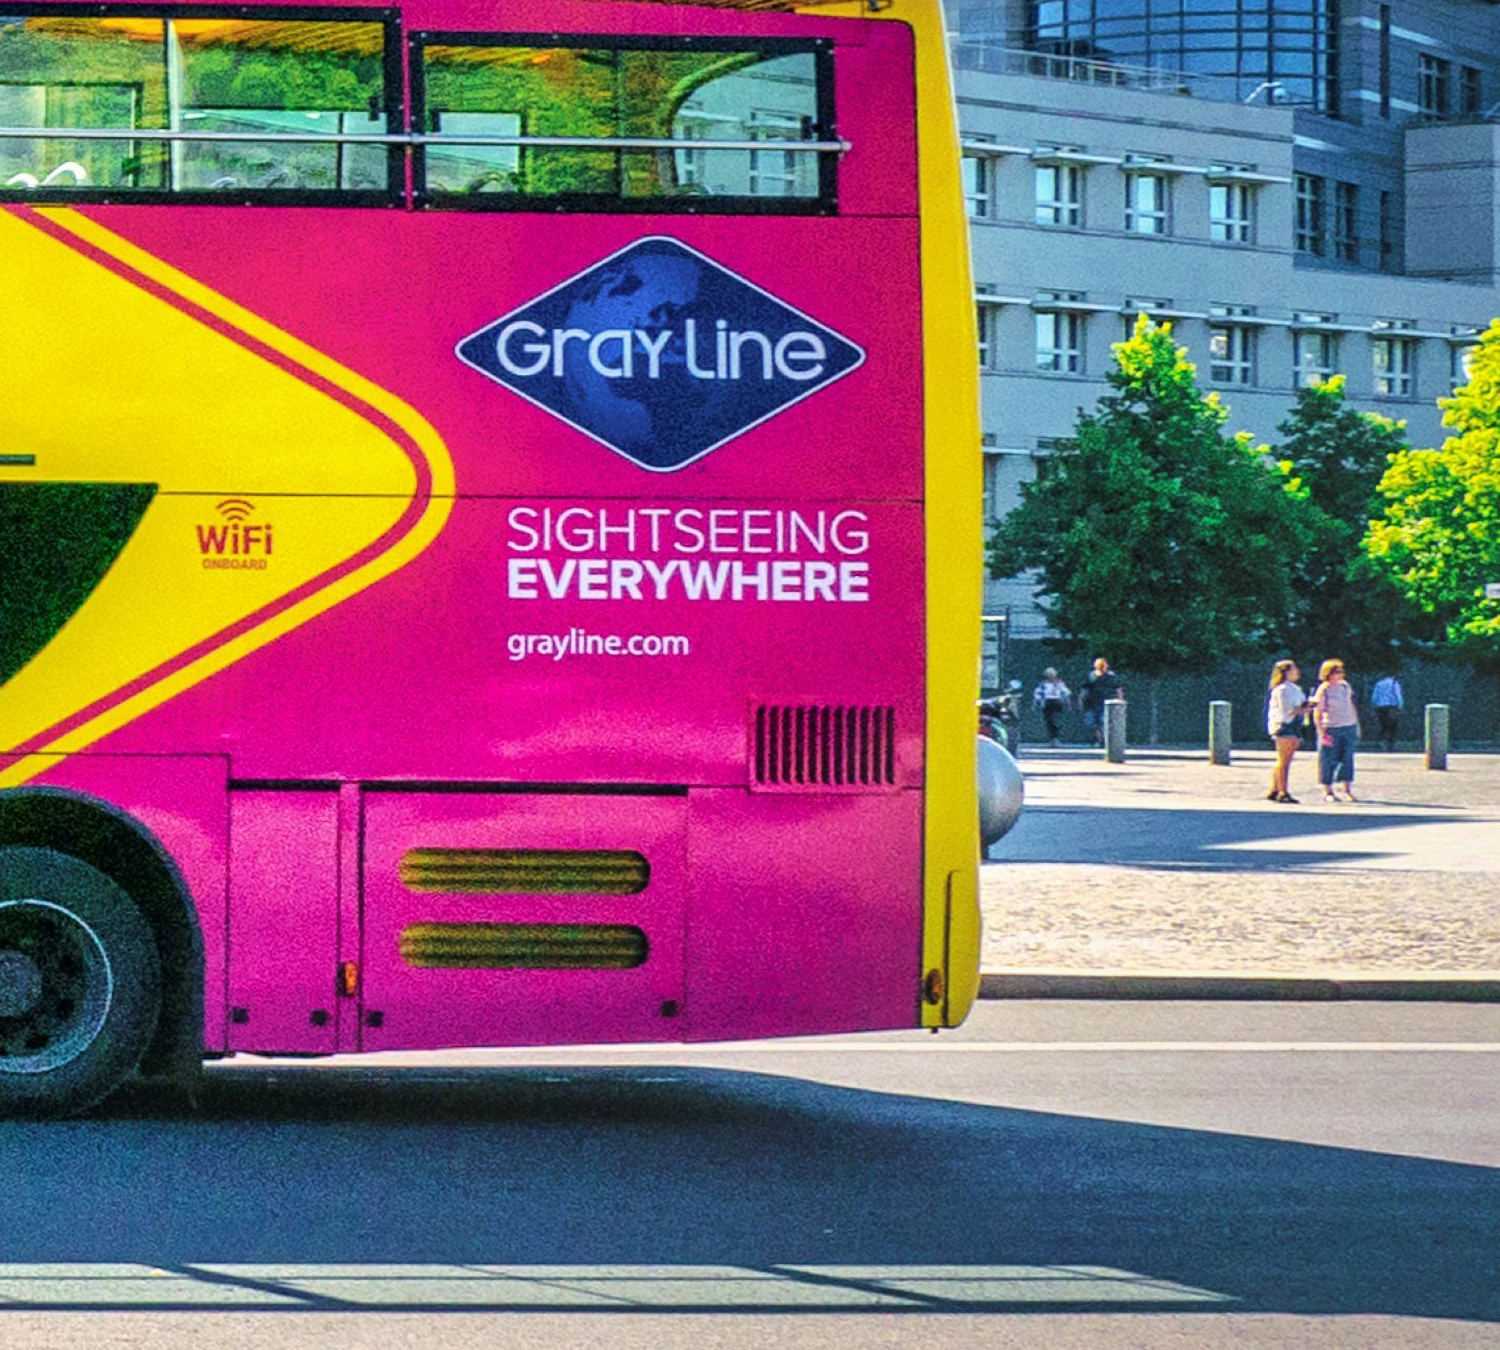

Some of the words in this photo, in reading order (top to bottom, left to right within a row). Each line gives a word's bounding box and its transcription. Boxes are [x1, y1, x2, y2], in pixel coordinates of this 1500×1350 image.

[496, 320, 672, 380] Gray
[685, 318, 827, 381] Line
[196, 523, 273, 555] WiFi
[507, 507, 870, 555] SIGHTSEEING
[202, 558, 268, 570] ONBOARD
[507, 558, 870, 602] EVERYWHERE
[507, 628, 690, 661] grayline.com
